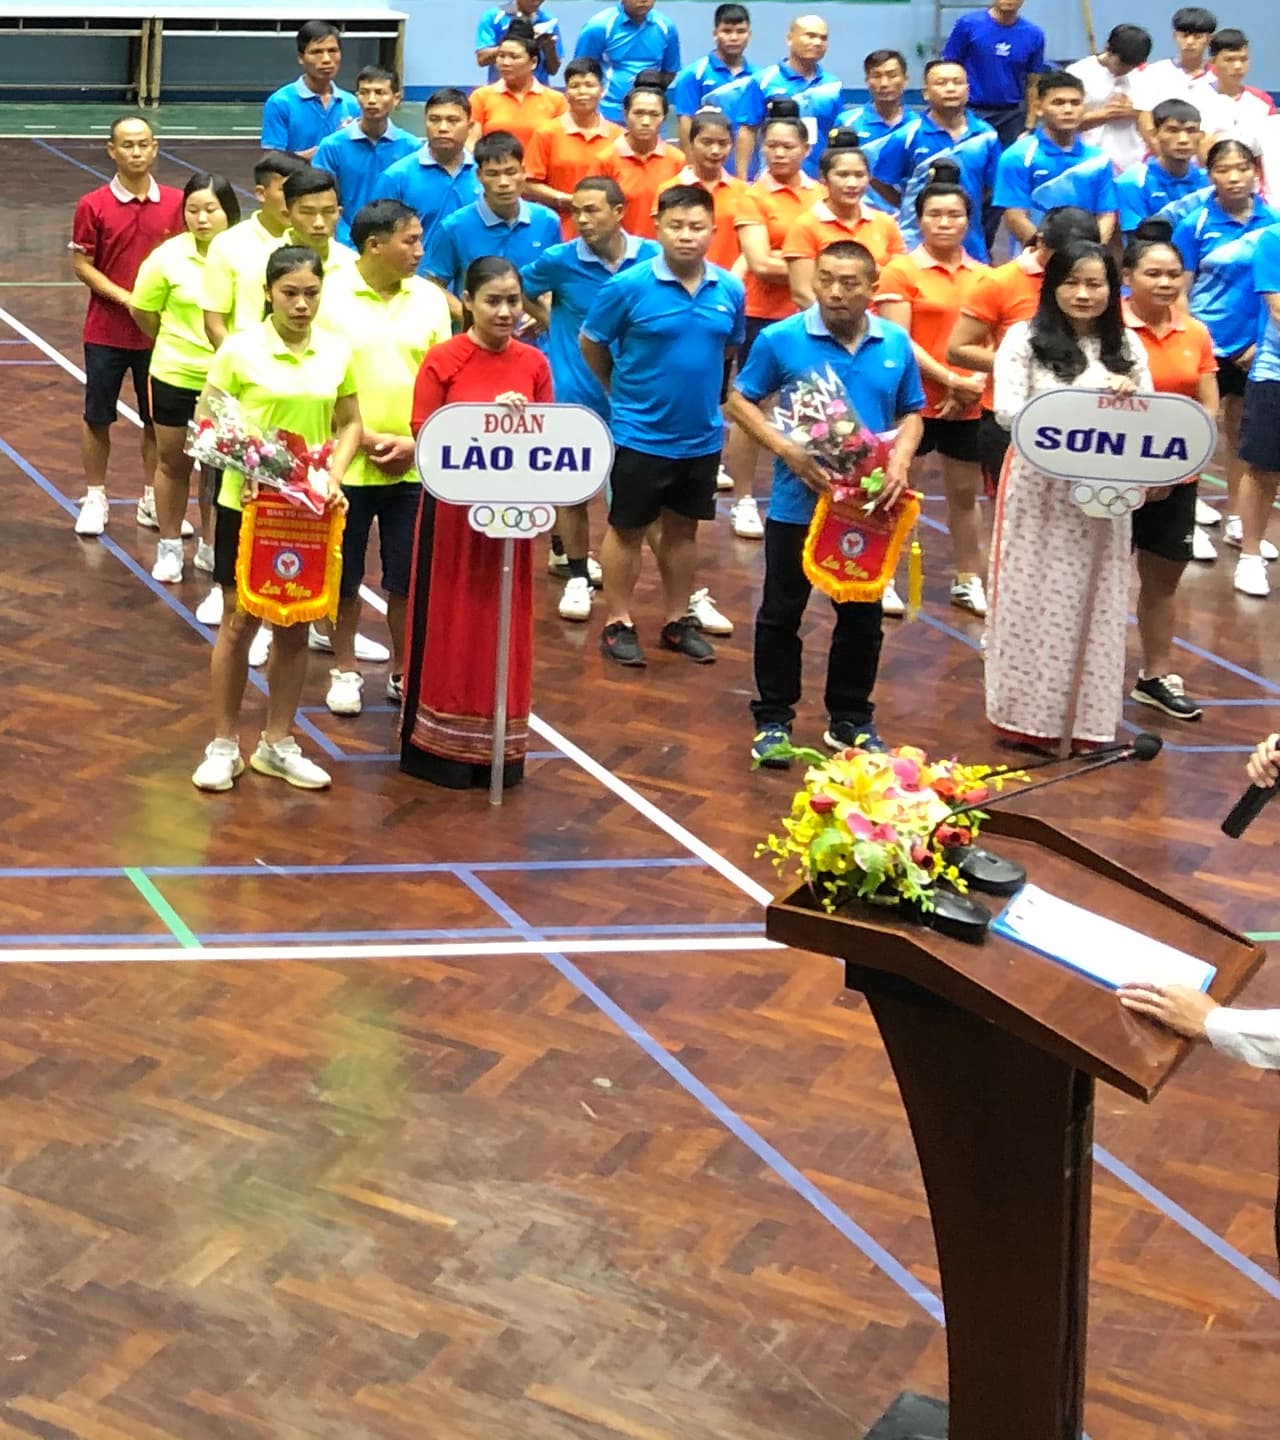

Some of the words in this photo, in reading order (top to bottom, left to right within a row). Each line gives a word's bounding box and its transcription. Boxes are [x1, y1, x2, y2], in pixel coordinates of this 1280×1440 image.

[442, 437, 514, 470] LÀO
[529, 446, 591, 471] CAI
[1034, 426, 1126, 455] SƠN
[1141, 435, 1188, 460] LA
